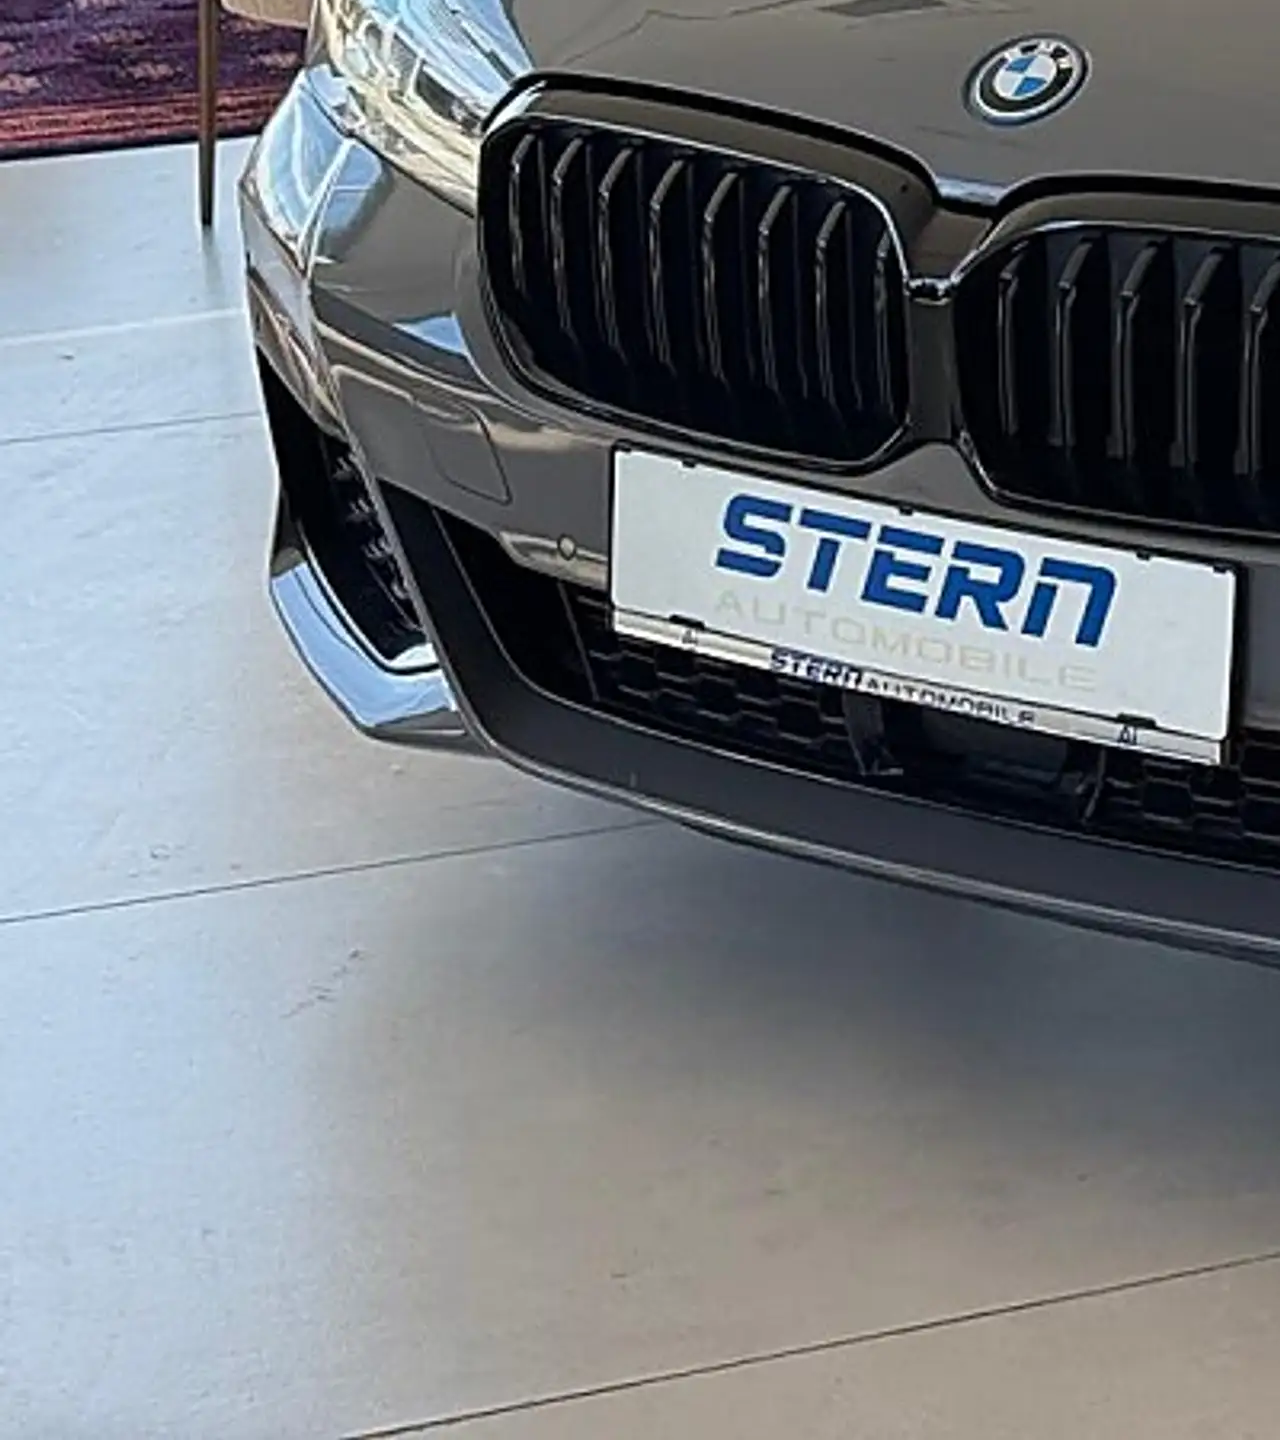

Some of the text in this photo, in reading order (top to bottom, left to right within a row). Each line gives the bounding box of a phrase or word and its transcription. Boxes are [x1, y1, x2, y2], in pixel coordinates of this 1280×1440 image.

[715, 492, 1117, 648] STERN
[715, 590, 1098, 692] AUTOMOBILE
[770, 648, 1035, 724] STERN AUTOMOBILE
